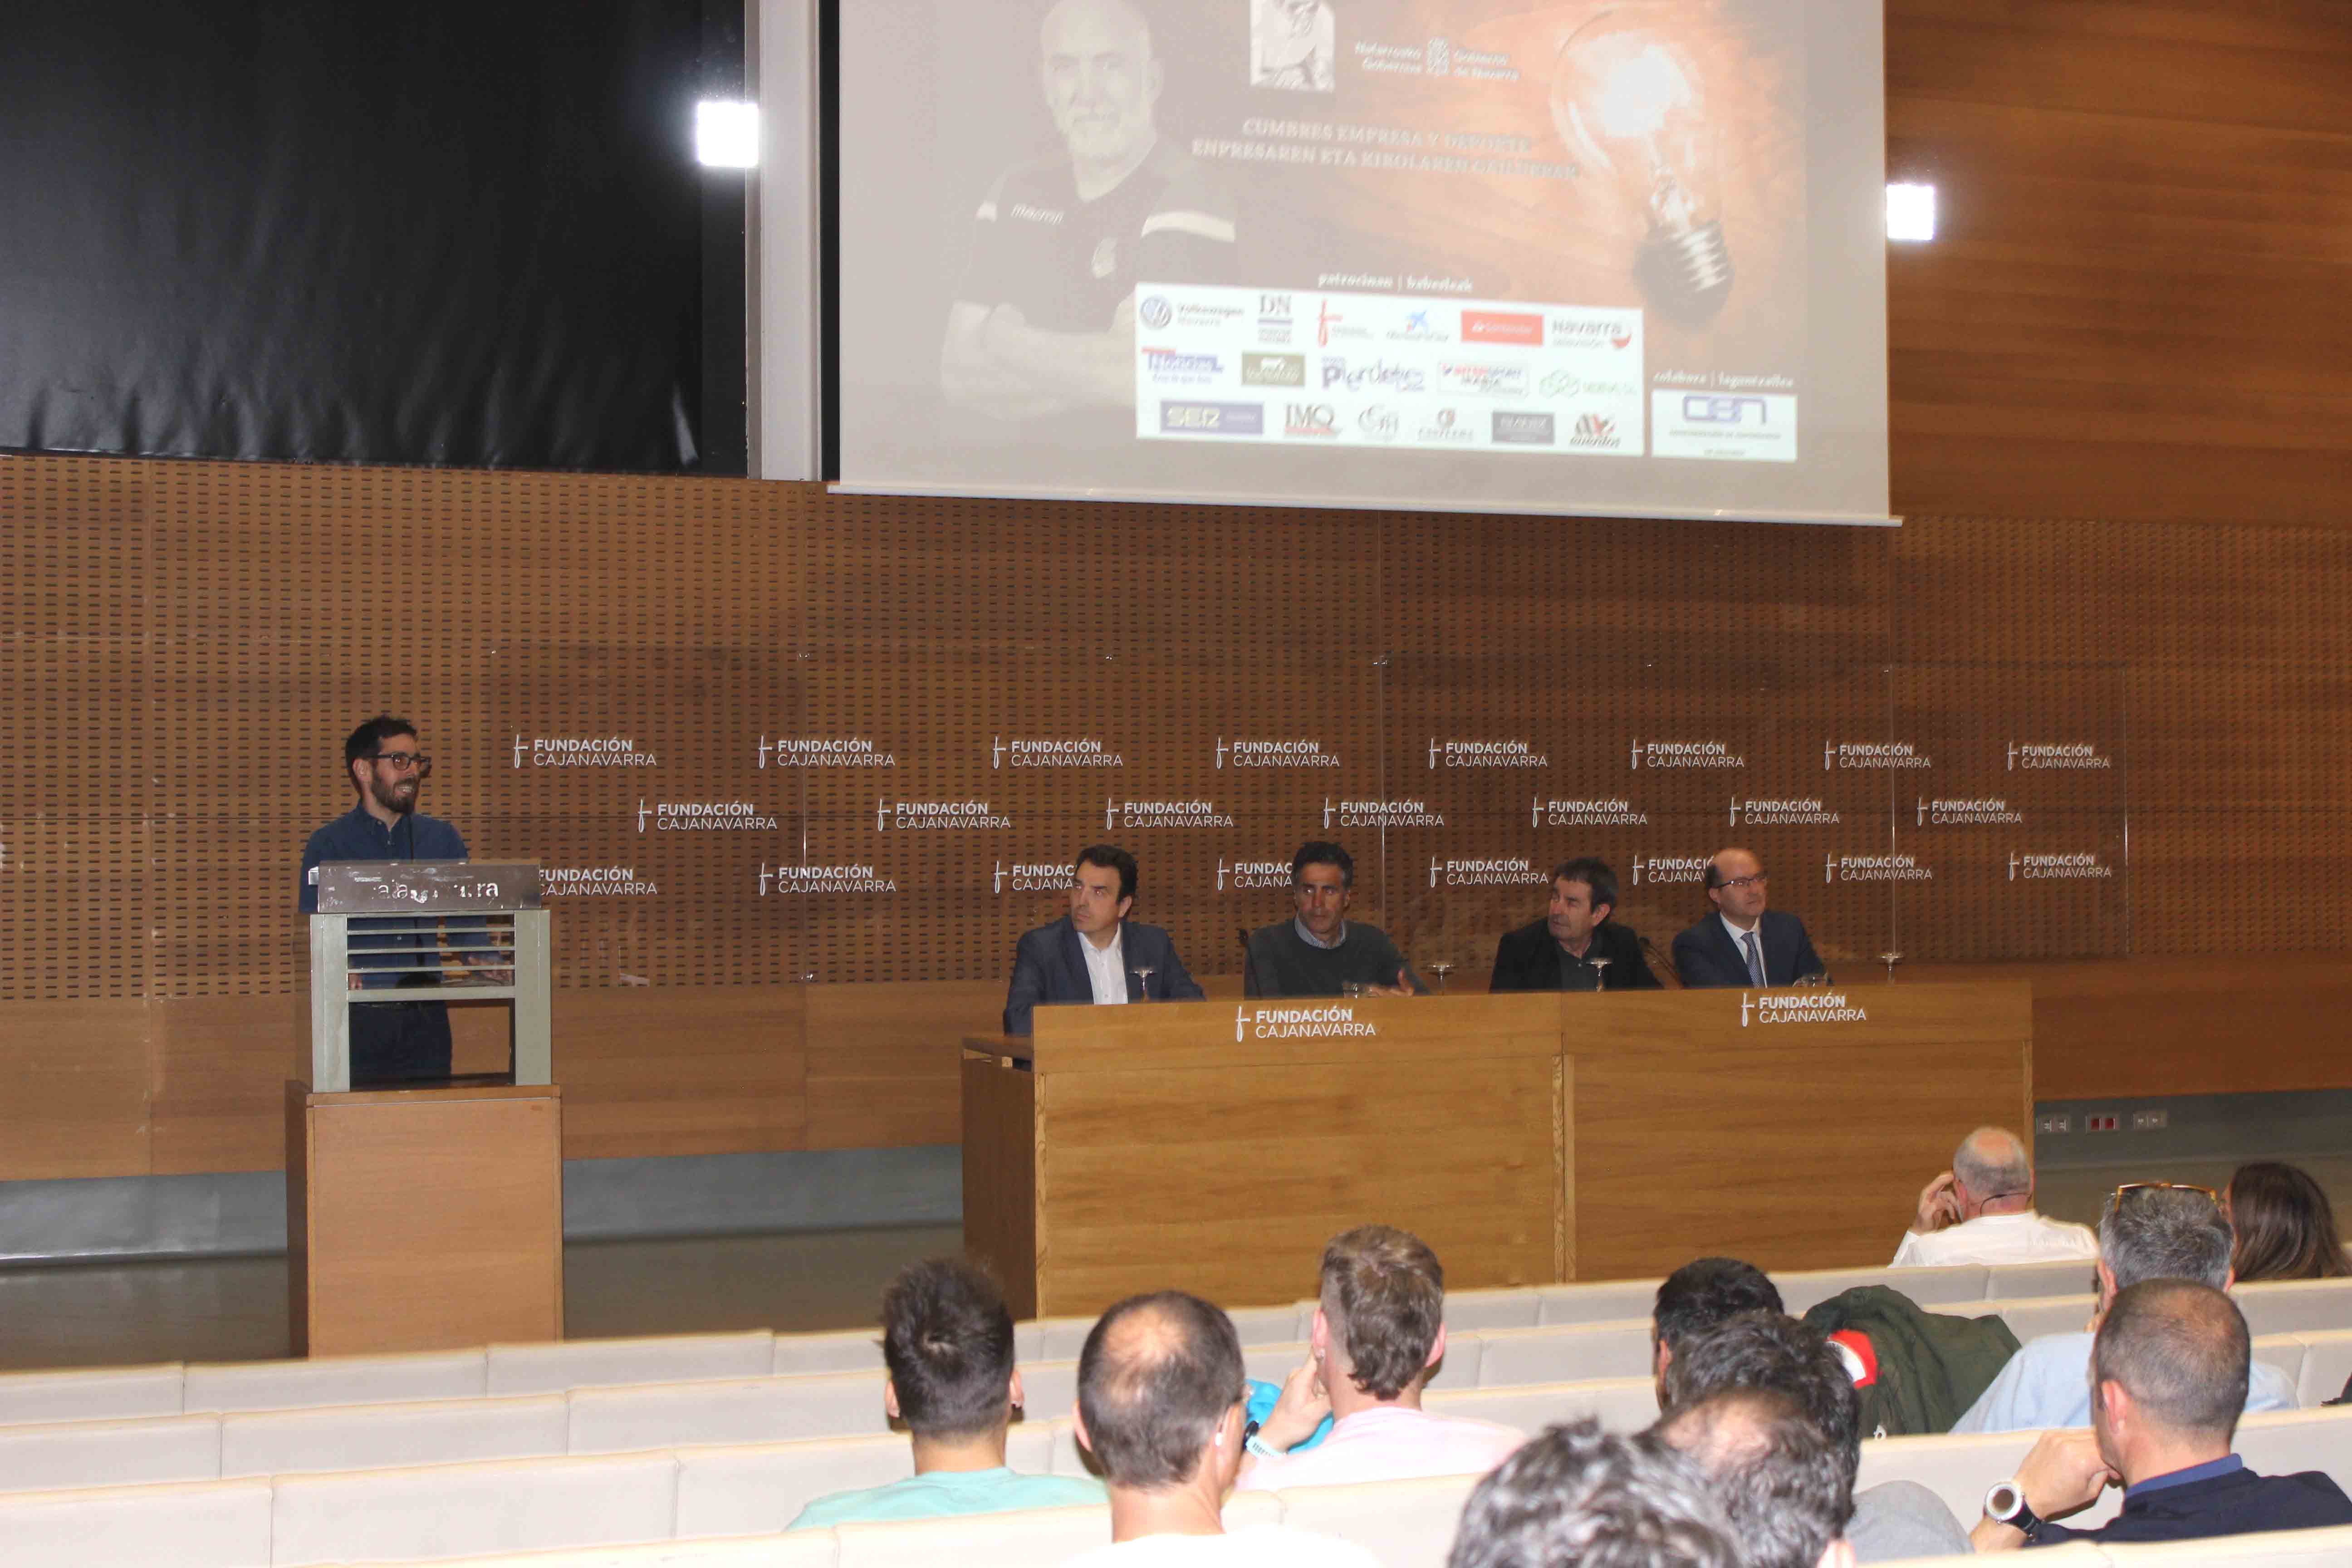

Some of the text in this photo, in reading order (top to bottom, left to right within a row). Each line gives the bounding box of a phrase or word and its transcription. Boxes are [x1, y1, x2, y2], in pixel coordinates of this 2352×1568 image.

[1242, 117, 1333, 139] CUMBRES
[1336, 123, 1423, 146] EMPRESA
[1428, 132, 1440, 147] Y
[1192, 137, 1317, 164] ENPRESAREN
[1319, 147, 1357, 167] ETA
[1318, 273, 1393, 288] patrocinan
[1259, 295, 1292, 314] DN
[1552, 318, 1623, 335] Navarra
[1166, 407, 1220, 427] SER
[534, 737, 632, 752] FUNDACIÓN
[778, 736, 872, 752] FUNDACIÓN
[1012, 738, 1101, 752] FUNDACIÓN
[1234, 739, 1318, 754] FUNDACIÓN
[1446, 740, 1527, 754] FUNDACIÓN
[1648, 741, 1725, 755] FUNDACIÓN
[1840, 743, 1912, 755] FUNDACIÓN
[2023, 744, 2092, 757] FUNDACIÓN
[534, 754, 657, 766] CAJANAVARRA
[778, 755, 895, 766] CAJANAVARRA
[1011, 755, 1122, 766] CAJANAVARRA
[1233, 755, 1339, 766] CAJANAVARRA
[1446, 755, 1547, 766] CAJANAVARRA
[1647, 756, 1744, 767] CAJANAVARRA
[1839, 758, 1931, 769] CAJANAVARRA
[2022, 758, 2110, 769] CAJANAVARRA
[658, 801, 753, 815] FUNDACIÓN
[897, 800, 988, 814] FUNDACIÓN
[1124, 799, 1211, 813] FUNDACIÓN
[1341, 799, 1423, 813] FUNDACIÓN
[1548, 799, 1628, 812] FUNDACIÓN
[1745, 798, 1820, 812] FUNDACIÓN
[1932, 799, 2004, 811] FUNDACIÓN
[657, 818, 777, 830] CAJANAVARRA
[896, 817, 1010, 828] CAJANAVARRA
[1124, 816, 1233, 828] CAJANAVARRA
[1340, 815, 1444, 827] CAJANAVARRA
[1548, 813, 1647, 825] CAJANAVARRA
[1745, 813, 1839, 824] CAJANAVARRA
[1932, 813, 2022, 823] CAJANAVARRA
[1447, 858, 1529, 872] FUNDACIÓN
[1649, 856, 1713, 870] FUNDACI
[1841, 854, 1914, 867] FUNDACIÓN
[2024, 853, 2093, 866] FUNDACIÓN
[779, 864, 872, 879] FUNDACIÓN
[1013, 865, 1074, 877] FUNDAC
[1235, 863, 1292, 874] FUNDAC
[1841, 869, 1932, 880] CAJANAVARRA
[2023, 867, 2111, 878] CAJANAVARRA
[1012, 878, 1073, 890] CAJANA
[1235, 876, 1292, 887] CAJANA
[1447, 873, 1548, 885] CAJANAVARRA
[541, 882, 657, 896] AJANAVARRA
[778, 881, 896, 892] CAJANAVARRA
[1759, 993, 1845, 1009] FUNDACIÓN
[1256, 1006, 1352, 1024] FUNDACIÓN
[1759, 1009, 1866, 1024] CAJANAVARRA
[1256, 1024, 1376, 1038] CAJANAVARRA
